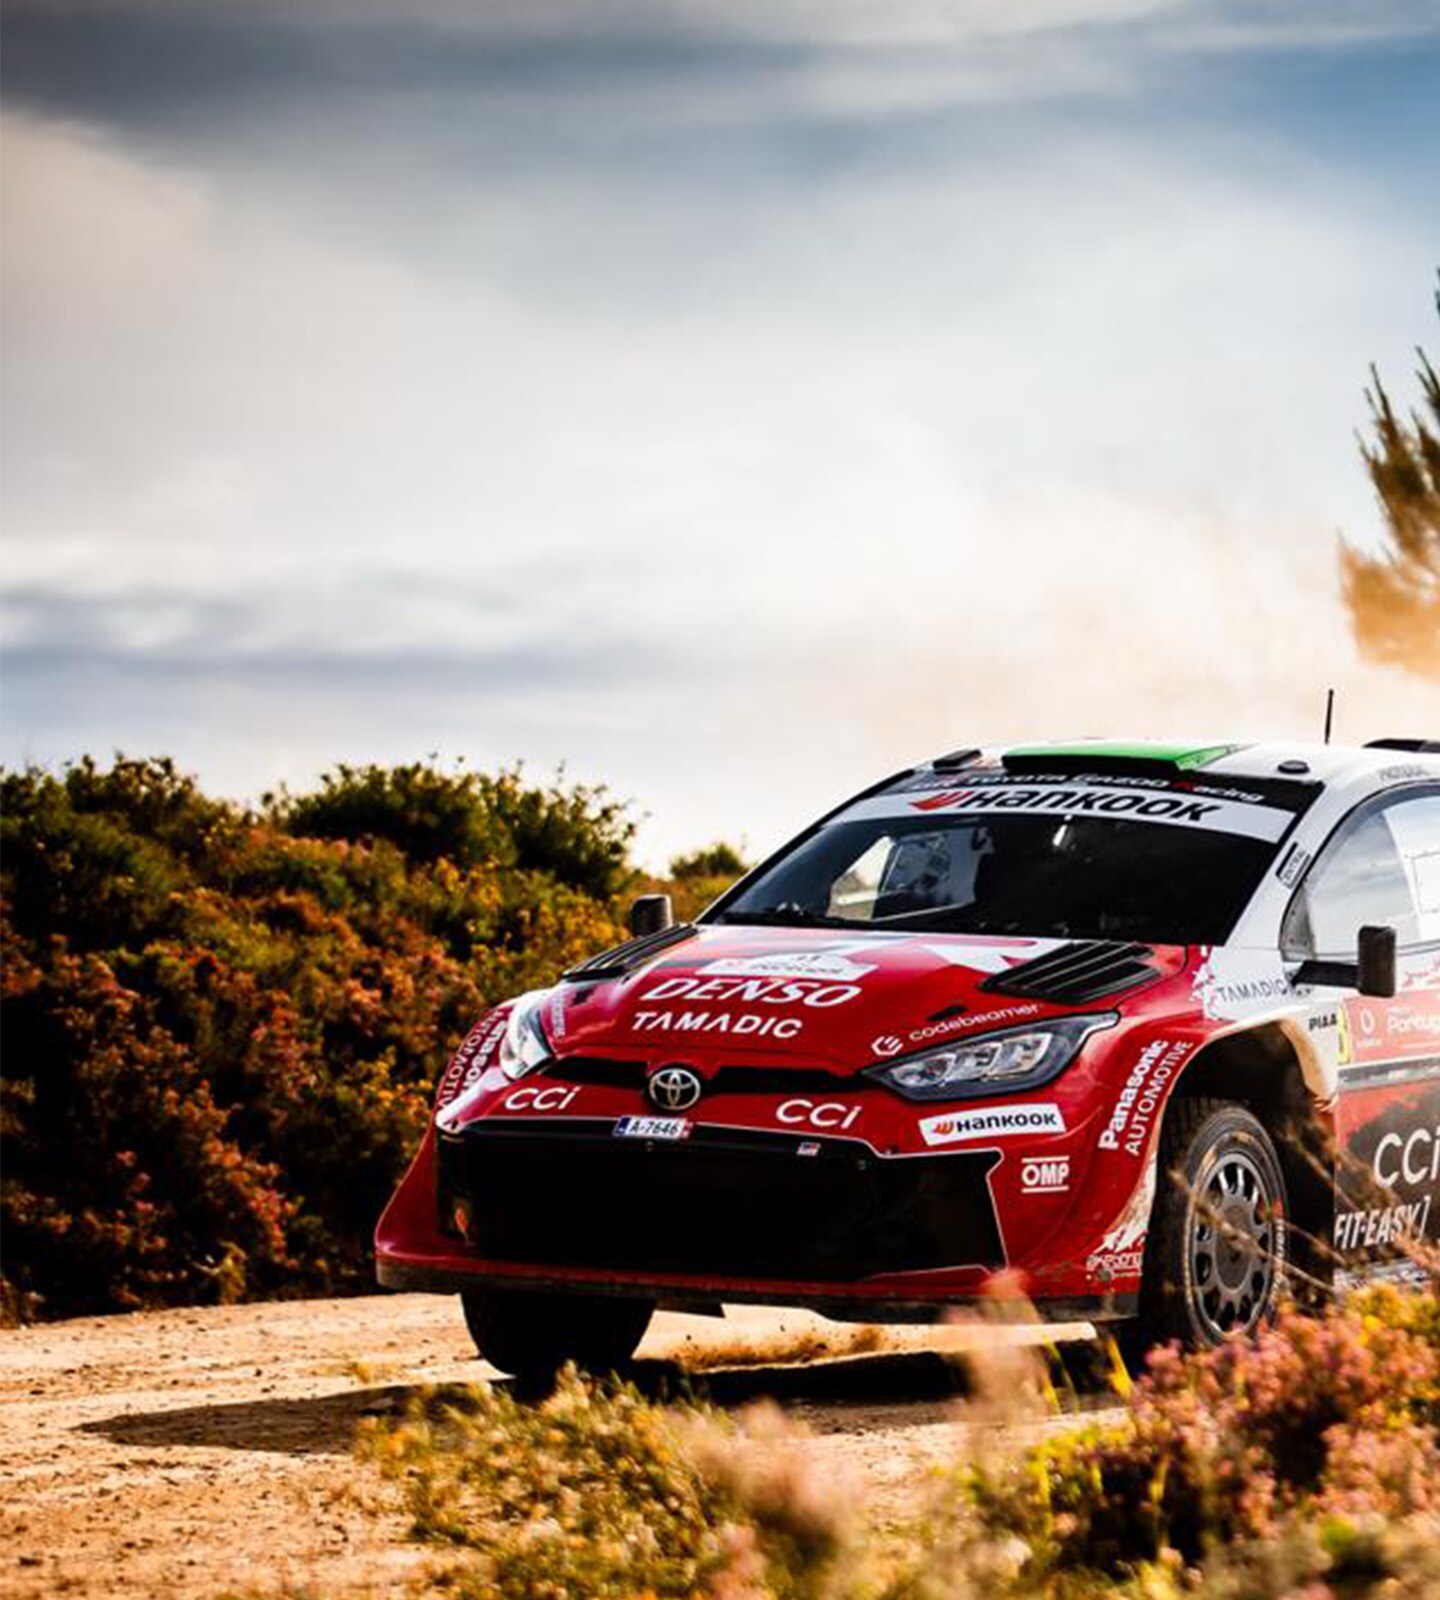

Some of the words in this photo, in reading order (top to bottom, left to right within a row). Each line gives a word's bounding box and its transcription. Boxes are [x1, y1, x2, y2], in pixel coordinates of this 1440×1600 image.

[1171, 780, 1264, 802] Racing
[639, 978, 862, 1008] DENSO
[630, 1011, 803, 1039] TAMADIC
[908, 1003, 1041, 1042] codebeamer
[1308, 1014, 1337, 1031] PIAA
[1098, 1039, 1170, 1150] Panasonic
[1124, 1041, 1194, 1158] AUTOMOTIVE
[629, 1119, 680, 1136] A-7646
[1021, 1163, 1070, 1186] OMP
